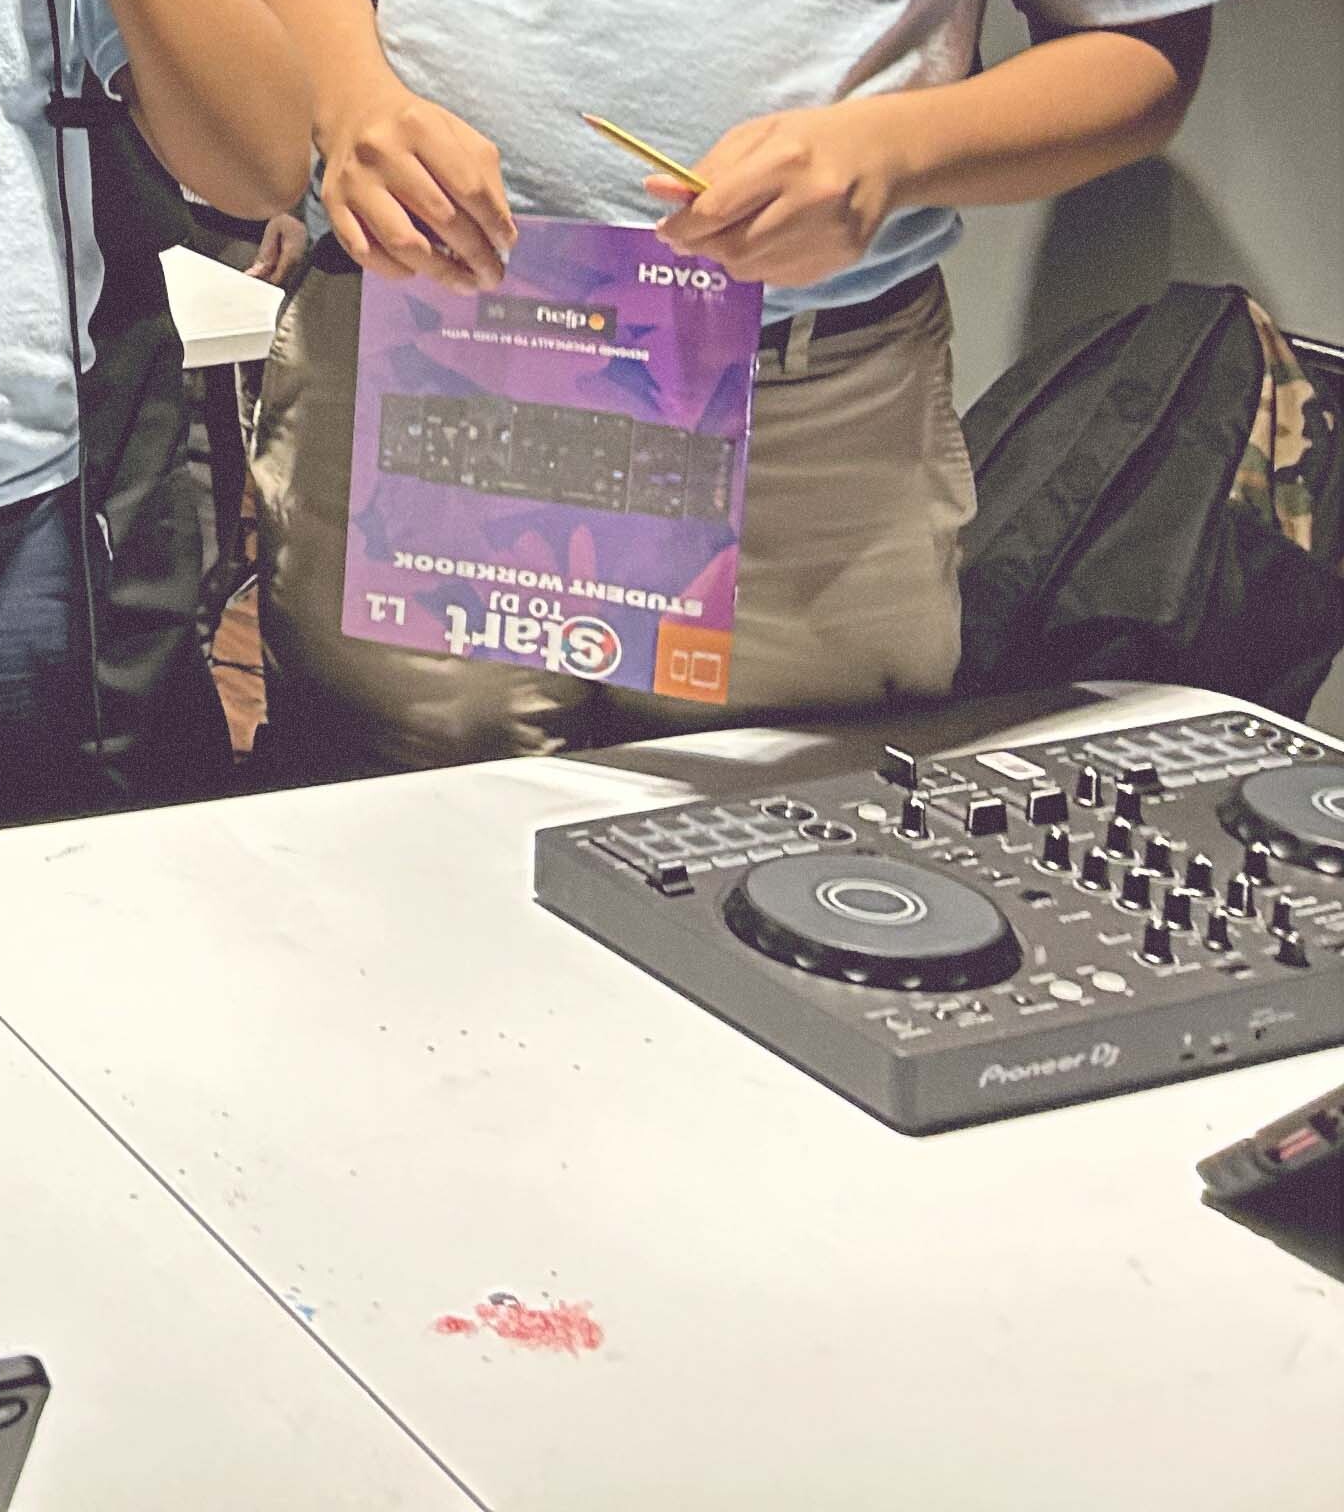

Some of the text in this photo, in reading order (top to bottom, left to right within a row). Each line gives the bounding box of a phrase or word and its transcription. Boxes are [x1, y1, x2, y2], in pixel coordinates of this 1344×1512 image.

[638, 262, 728, 292] COACH
[393, 552, 704, 618] STUDENT WORKBOOK
[366, 592, 407, 625] L1
[488, 590, 564, 622] TO DJ
[978, 1052, 1087, 1089] Pioneer
